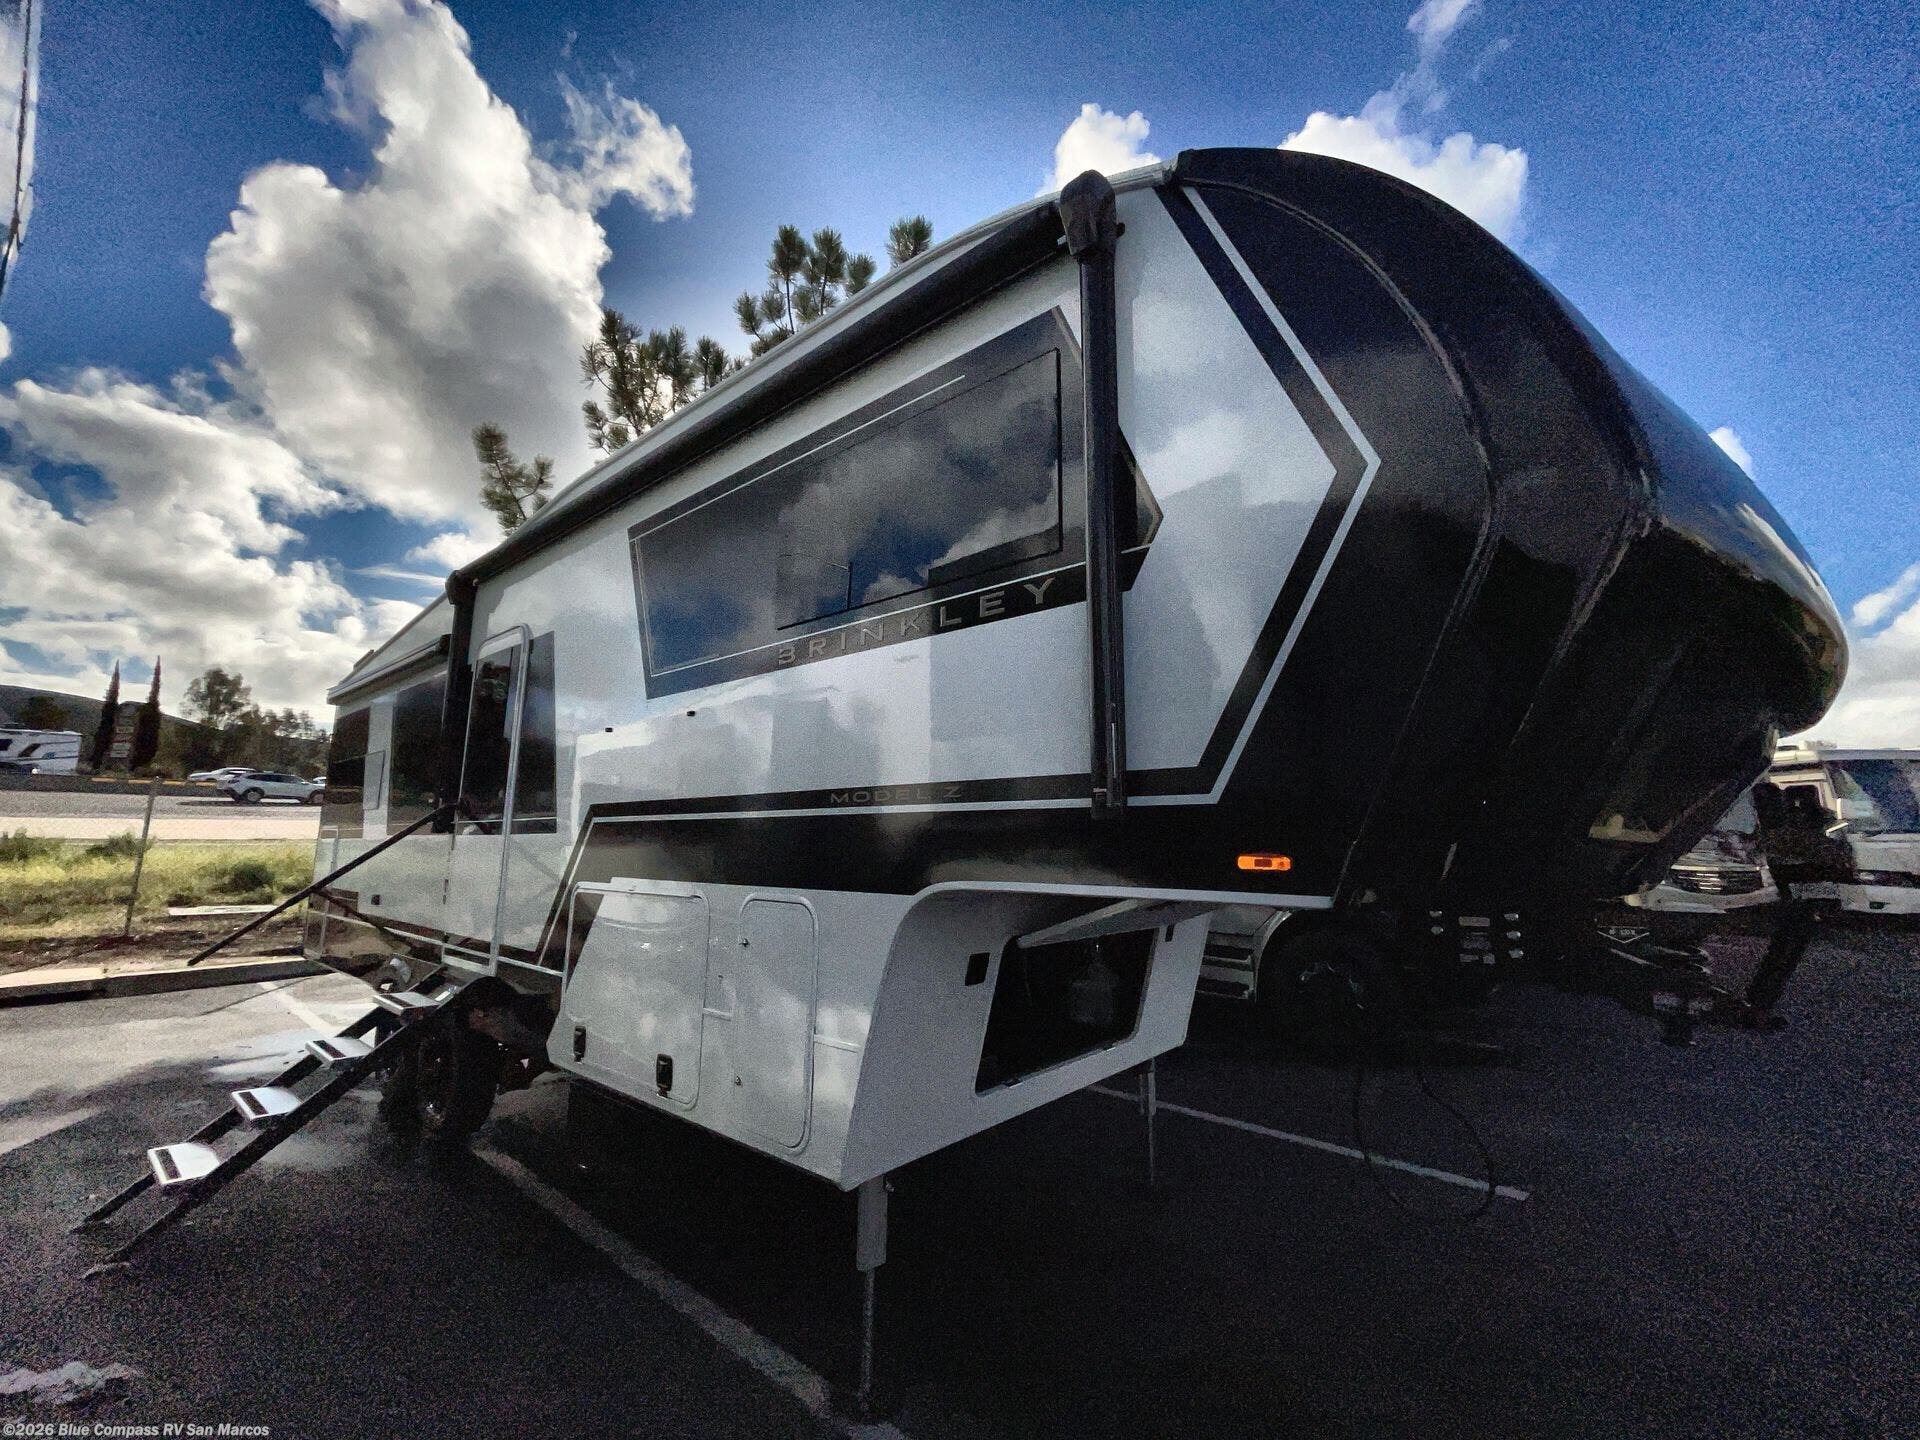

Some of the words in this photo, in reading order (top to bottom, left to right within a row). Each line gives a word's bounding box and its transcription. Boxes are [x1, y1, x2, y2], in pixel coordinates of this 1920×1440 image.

[778, 577, 1056, 666] BRINKLEY
[830, 786, 931, 804] MODEL
[943, 784, 963, 800] Z
